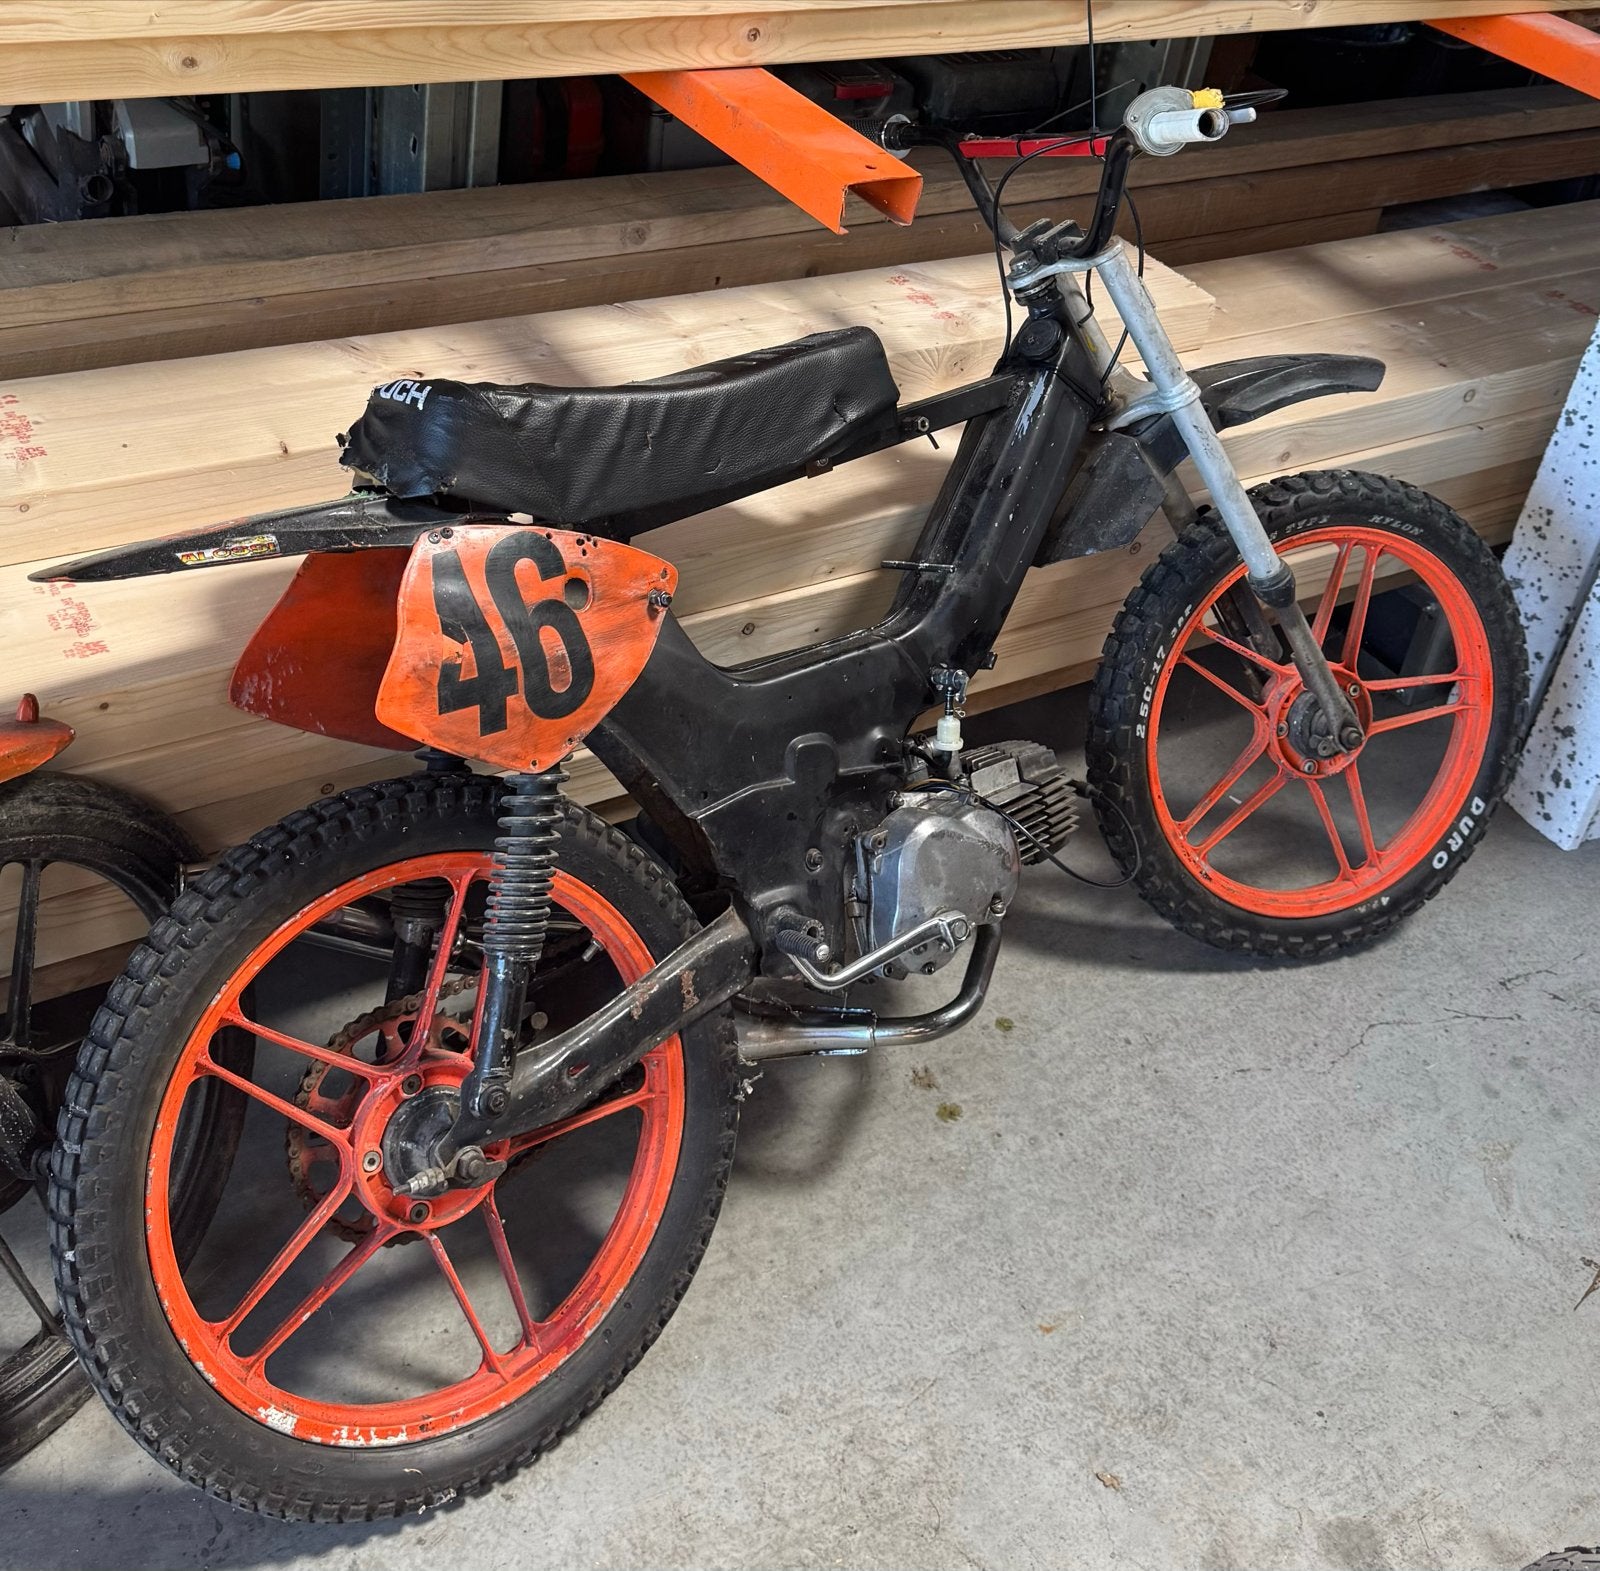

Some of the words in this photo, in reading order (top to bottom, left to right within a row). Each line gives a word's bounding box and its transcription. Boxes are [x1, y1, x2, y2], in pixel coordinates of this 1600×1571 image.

[376, 379, 432, 411] UCH
[1368, 514, 1425, 536] NYLON
[431, 530, 595, 737] 46
[1432, 796, 1486, 869] DURO
